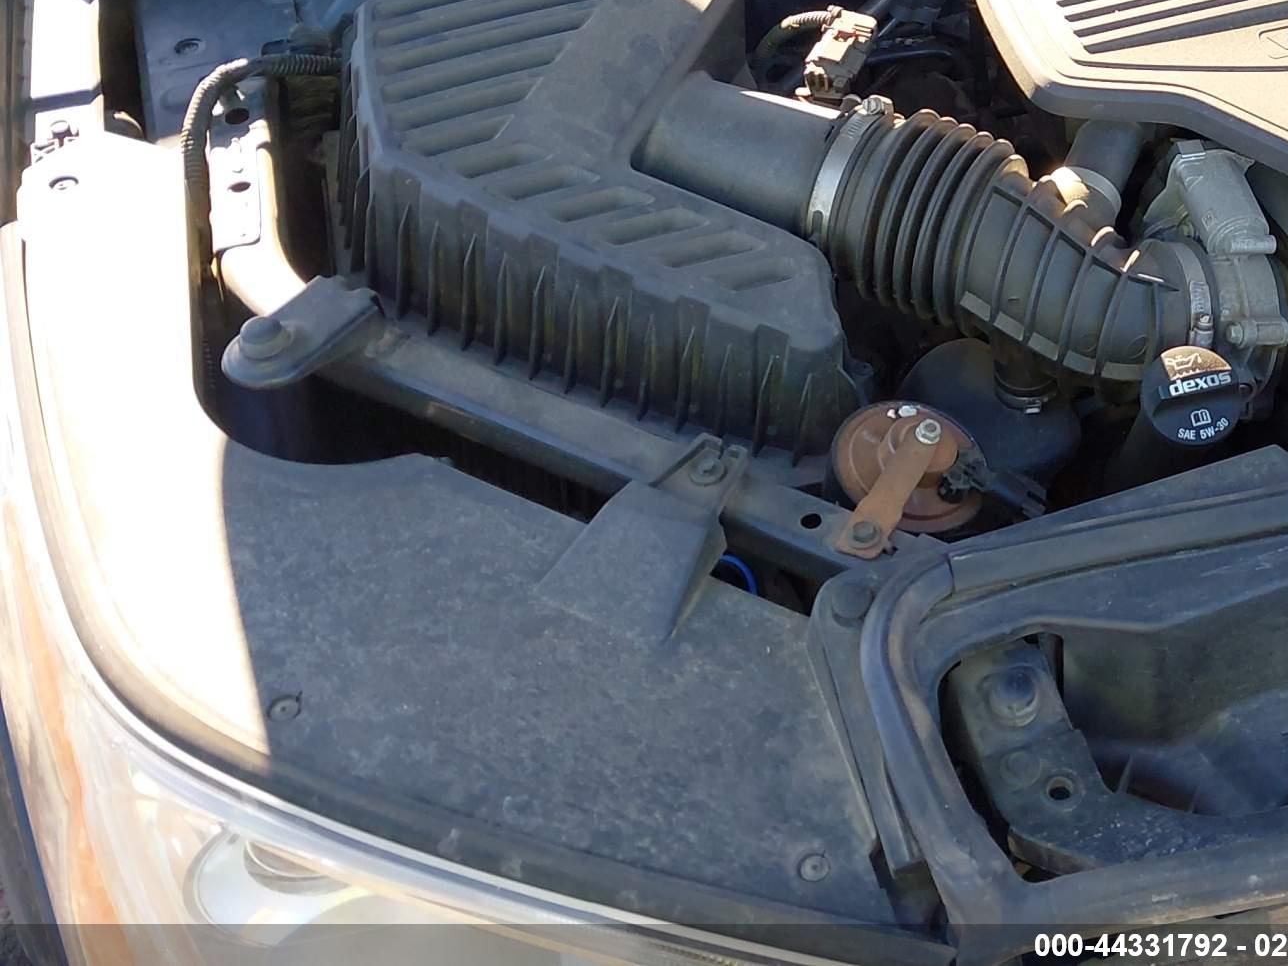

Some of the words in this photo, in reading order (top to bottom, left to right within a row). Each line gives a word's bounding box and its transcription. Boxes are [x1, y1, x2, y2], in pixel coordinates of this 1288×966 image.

[1169, 371, 1232, 396] dexos
[1178, 428, 1196, 440] SAE
[1200, 417, 1229, 440] 5W-30
